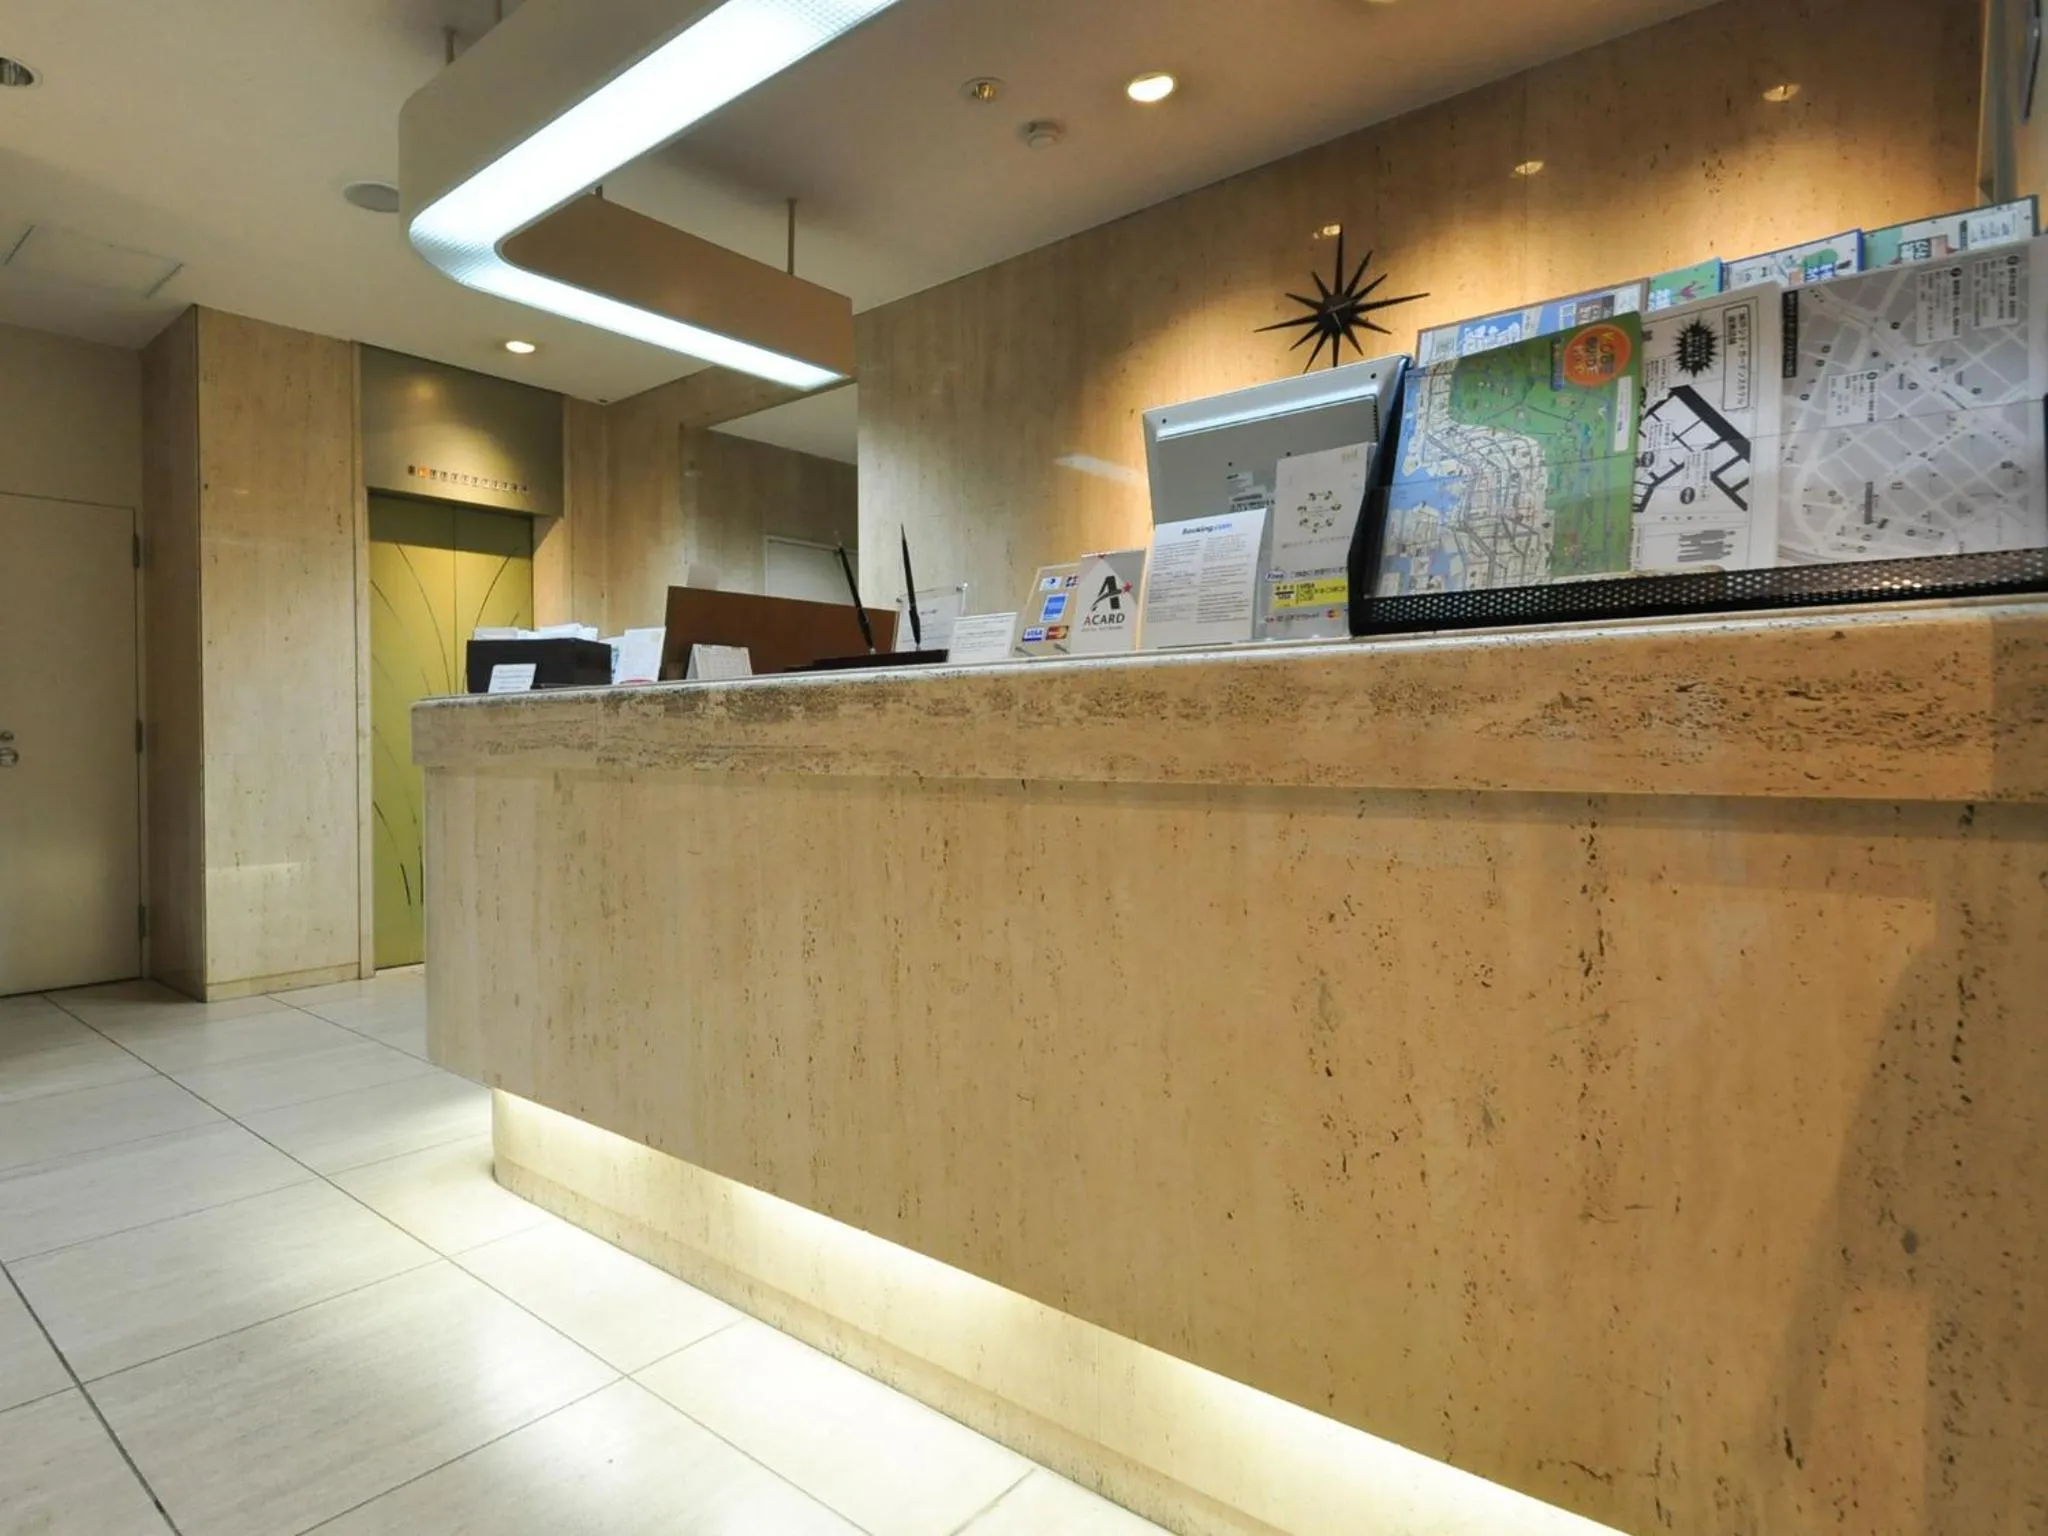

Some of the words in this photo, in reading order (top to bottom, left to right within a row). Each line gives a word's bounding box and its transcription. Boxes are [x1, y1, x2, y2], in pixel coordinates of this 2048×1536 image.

[1182, 522, 1232, 536] Booking.com
[1083, 612, 1126, 627] ACARD
[1026, 629, 1043, 637] VISA
